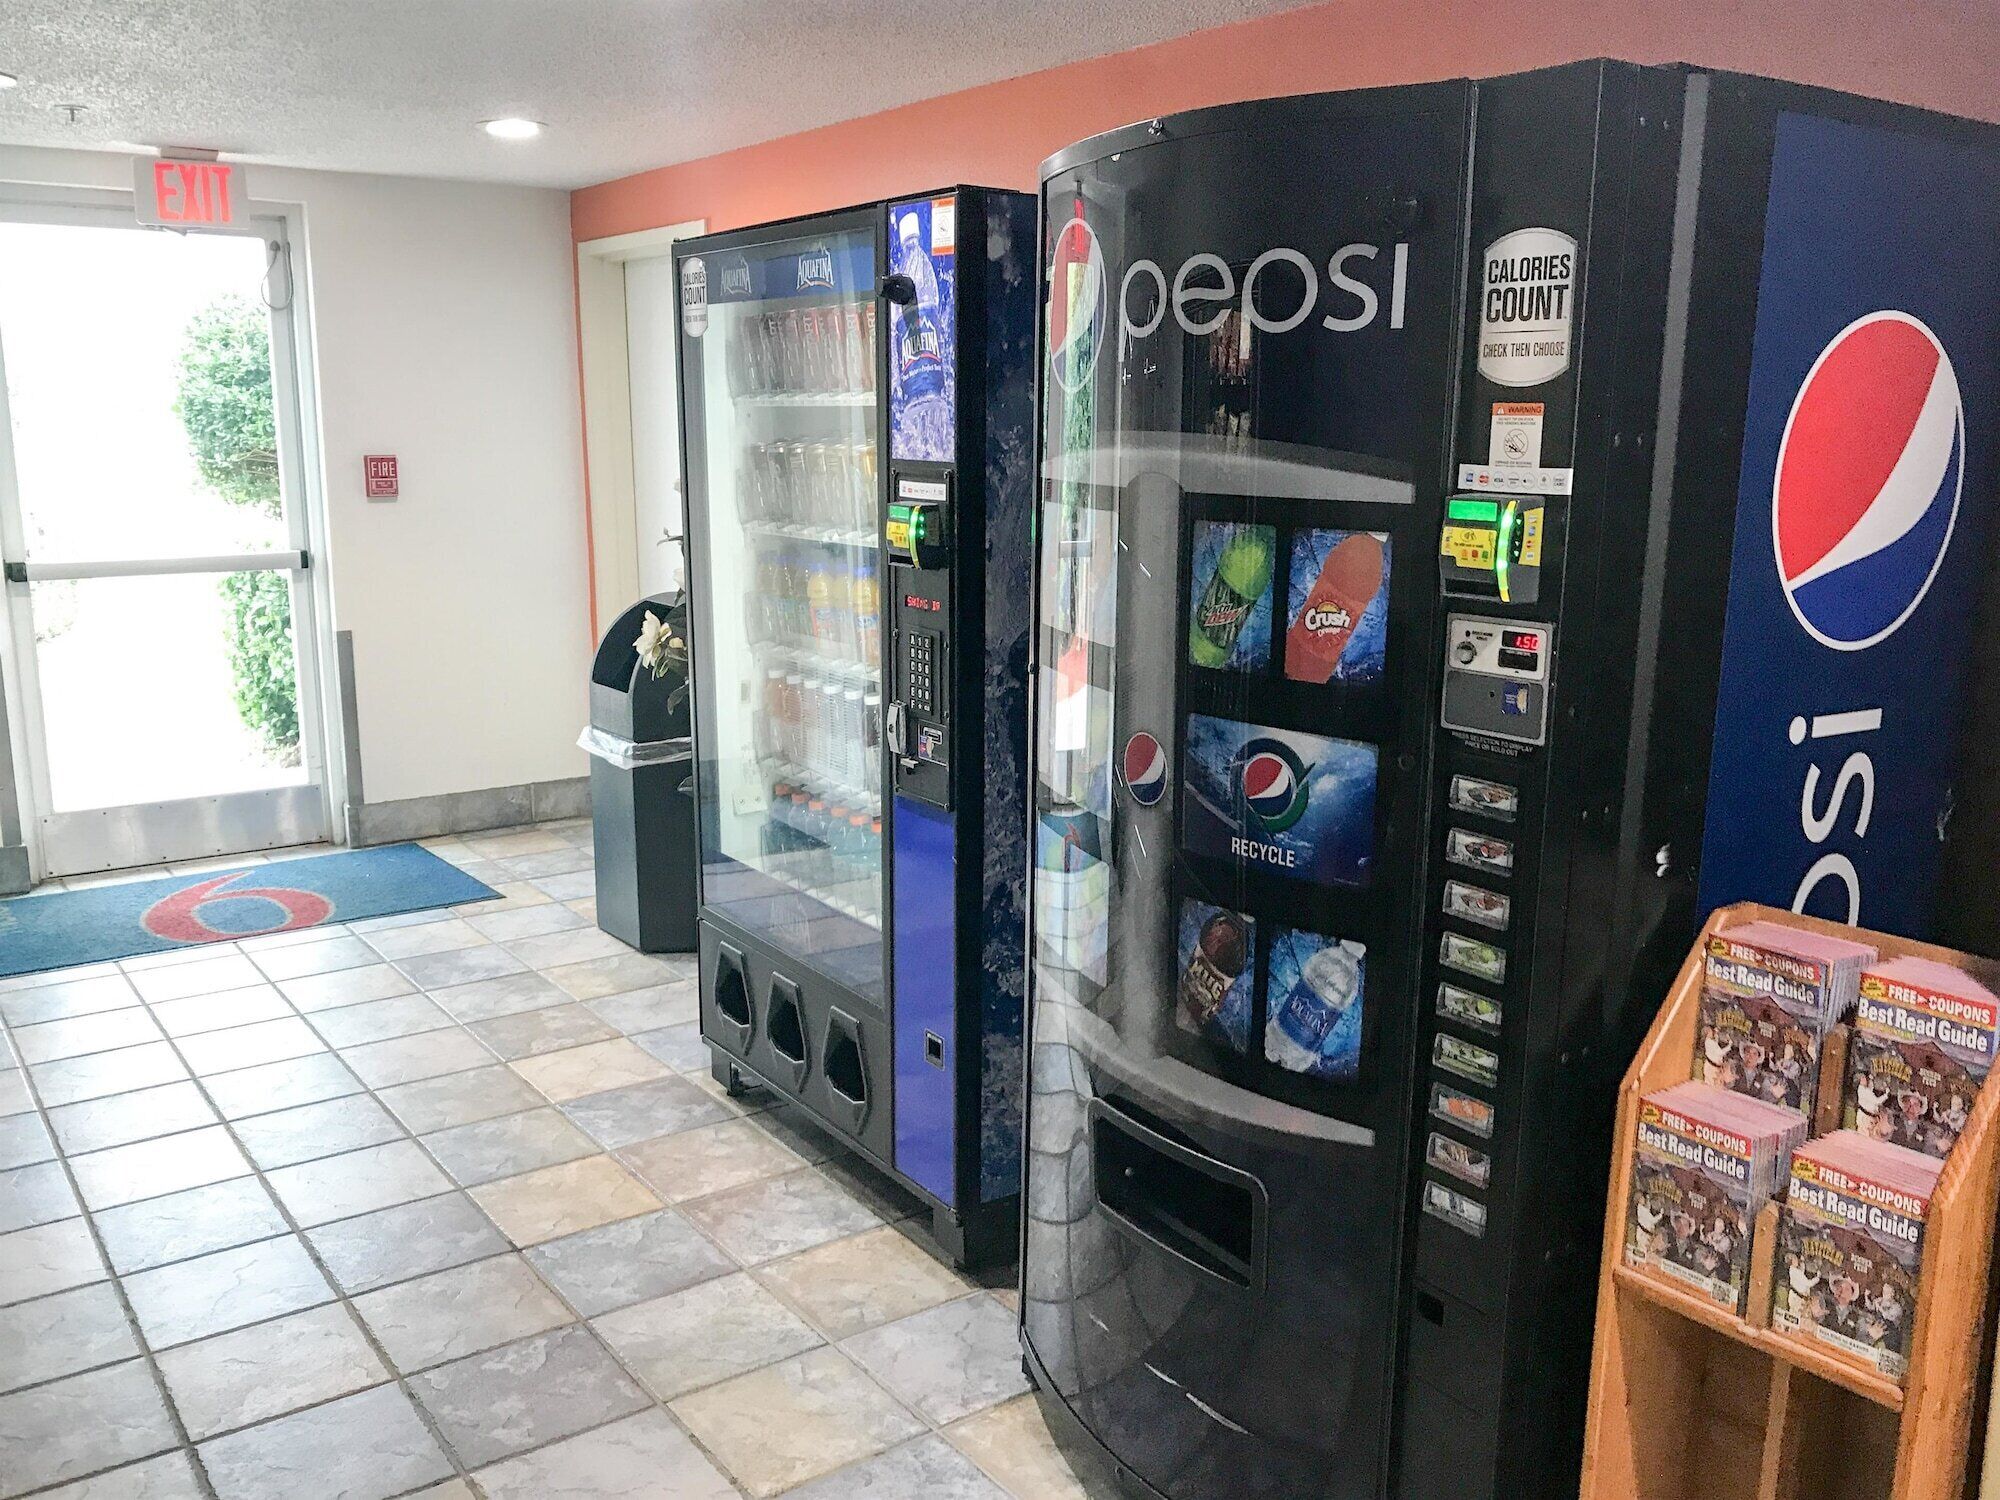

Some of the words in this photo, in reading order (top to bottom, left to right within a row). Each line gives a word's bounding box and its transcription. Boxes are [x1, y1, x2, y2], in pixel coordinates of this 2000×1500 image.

[154, 163, 231, 222] EXIT
[684, 271, 706, 286] CALORIES
[720, 264, 752, 297] AQUAFINA
[796, 256, 835, 291] AQUAFINA
[1488, 254, 1571, 284] CALORIES
[685, 286, 706, 305] COUNT
[1486, 285, 1569, 323] COUNT
[901, 330, 941, 371] AQUAFINA
[1483, 343, 1508, 358] CHECK
[1511, 342, 1530, 357] THEN
[1533, 341, 1565, 357] CHOOSE
[1508, 405, 1542, 414] WARNING
[371, 461, 396, 477] FIRE
[1305, 607, 1351, 630] Crush
[1506, 749, 1518, 757] OUT
[1231, 836, 1295, 868] RECYCLE
[139, 870, 335, 943] 6
[1706, 955, 1736, 982] Best
[1737, 965, 1773, 992] Read
[1774, 975, 1815, 1005] Guide
[1730, 943, 1755, 961] FREE
[1764, 954, 1815, 980] COUPONS
[1888, 984, 1917, 1005] FREE
[1928, 995, 1991, 1024] COUPONS
[1858, 996, 1894, 1026] Best
[1895, 1007, 1937, 1038] Read
[1938, 1019, 1988, 1052] Guide
[1662, 1110, 1687, 1131] FREE
[1695, 1124, 1747, 1154] COUPONS
[1638, 1122, 1668, 1150] Best
[1668, 1133, 1702, 1163] Read
[1704, 1147, 1745, 1180] Guide
[1819, 1166, 1847, 1189] FREE
[1859, 1181, 1921, 1215] COUPONS
[1789, 1177, 1825, 1209] Best
[1826, 1190, 1867, 1225] Read
[1869, 1207, 1919, 1243] Guide
